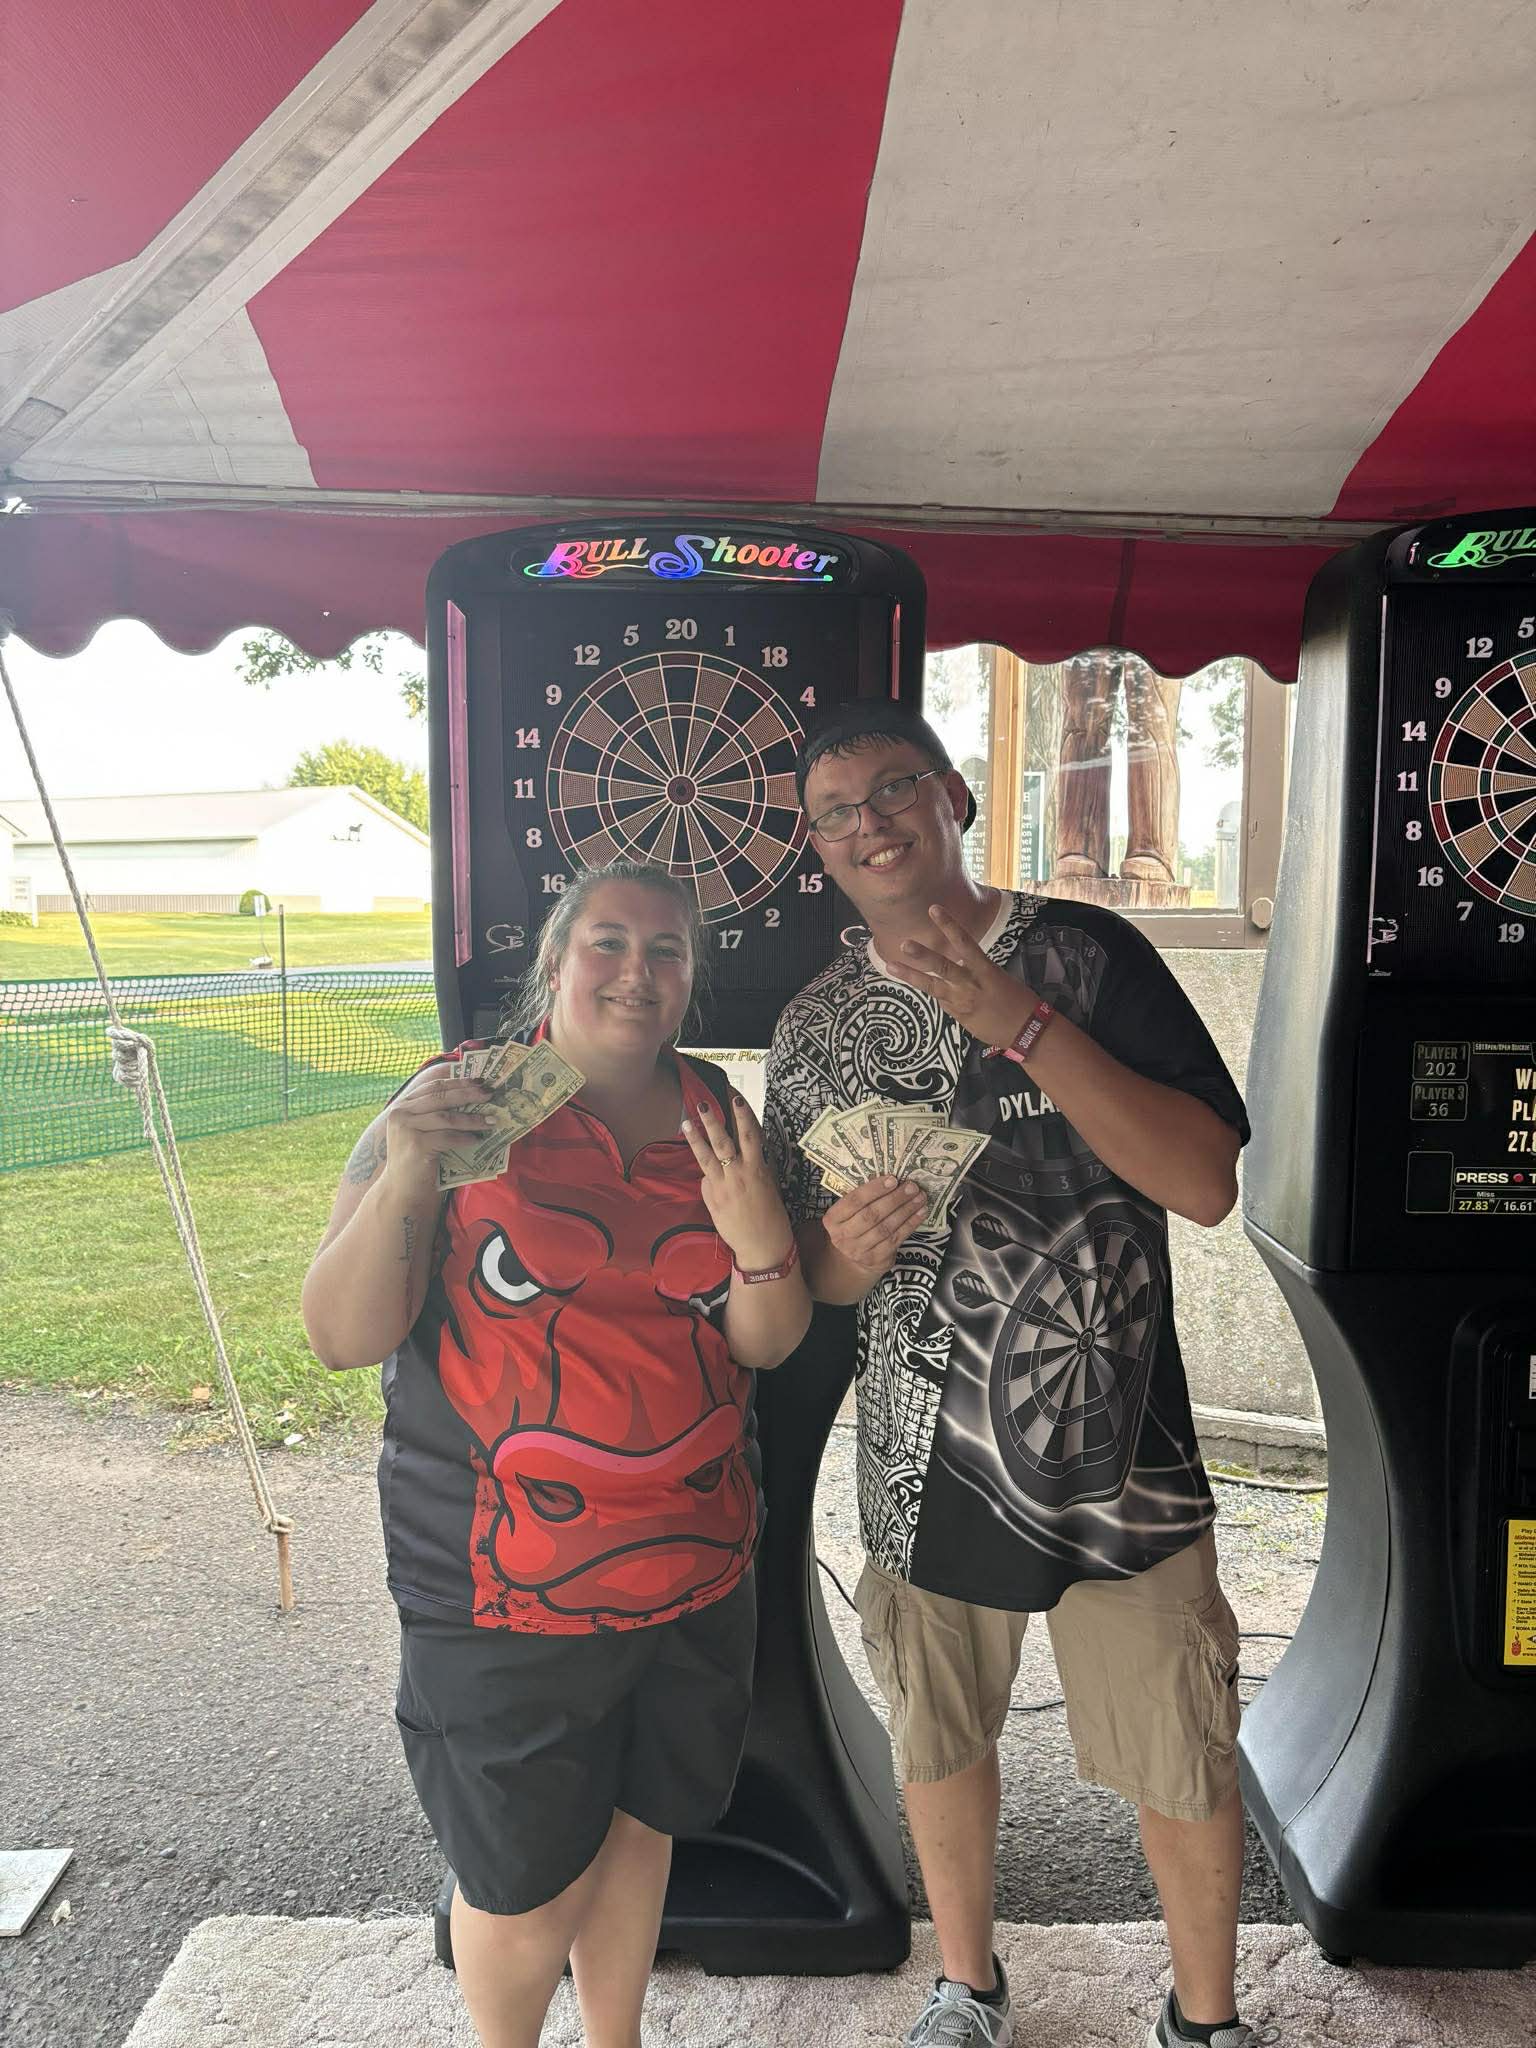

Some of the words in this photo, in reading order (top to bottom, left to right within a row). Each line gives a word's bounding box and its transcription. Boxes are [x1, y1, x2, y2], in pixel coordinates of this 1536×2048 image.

[1427, 528, 1536, 569] BUL
[622, 624, 640, 647] 5
[665, 618, 698, 640] 20
[723, 625, 736, 647] 1
[1518, 617, 1536, 637] 5
[573, 645, 600, 666] 12
[761, 647, 788, 668] 18
[1466, 637, 1493, 659] 12
[545, 685, 562, 705] 9
[799, 686, 816, 707] 4
[1435, 677, 1452, 698] 9
[515, 728, 541, 749] 14
[1402, 721, 1427, 742] 14
[513, 779, 537, 800] 11
[1397, 772, 1419, 792] 11
[525, 828, 542, 848] 8
[1406, 822, 1422, 842] 8
[541, 874, 567, 894] 16
[798, 873, 823, 894] 15
[1418, 867, 1444, 887] 16
[765, 909, 781, 928] 2
[1456, 902, 1474, 922] 7
[719, 930, 744, 950] 17
[1498, 923, 1525, 943] 19
[1416, 1045, 1458, 1060] PLAYER
[1425, 1062, 1457, 1076] 202
[1414, 1085, 1456, 1101] PLAYER
[1457, 1085, 1465, 1100] 3
[999, 1090, 1061, 1122] DYLA
[1428, 1102, 1449, 1117] 36
[1059, 1175, 1069, 1190] 3
[1456, 1172, 1509, 1184] PRESS
[1458, 1200, 1489, 1211] 27.83
[1504, 1201, 1532, 1211] 16.61
